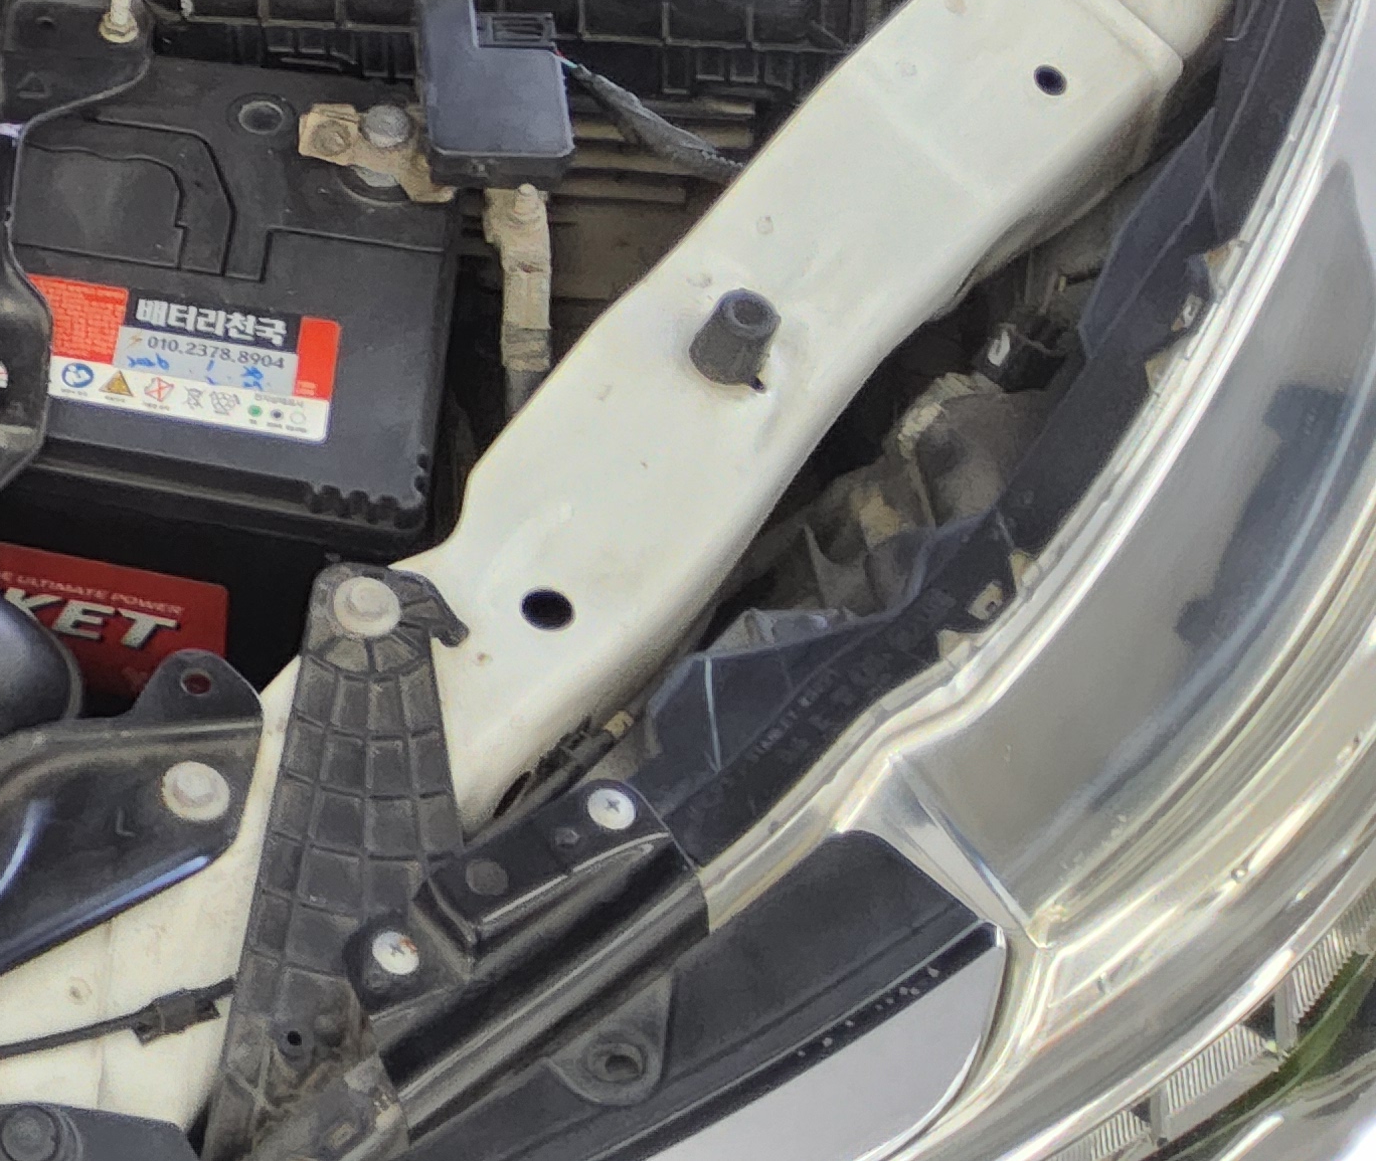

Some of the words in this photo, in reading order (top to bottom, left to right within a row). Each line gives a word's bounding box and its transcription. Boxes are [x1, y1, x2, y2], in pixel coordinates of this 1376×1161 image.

[135, 298, 287, 347] 배터리천국
[147, 336, 285, 369] 010.2378.8904
[2, 585, 180, 649] KET
[16, 575, 109, 600] ULTIMATE
[110, 592, 184, 615] POWER
